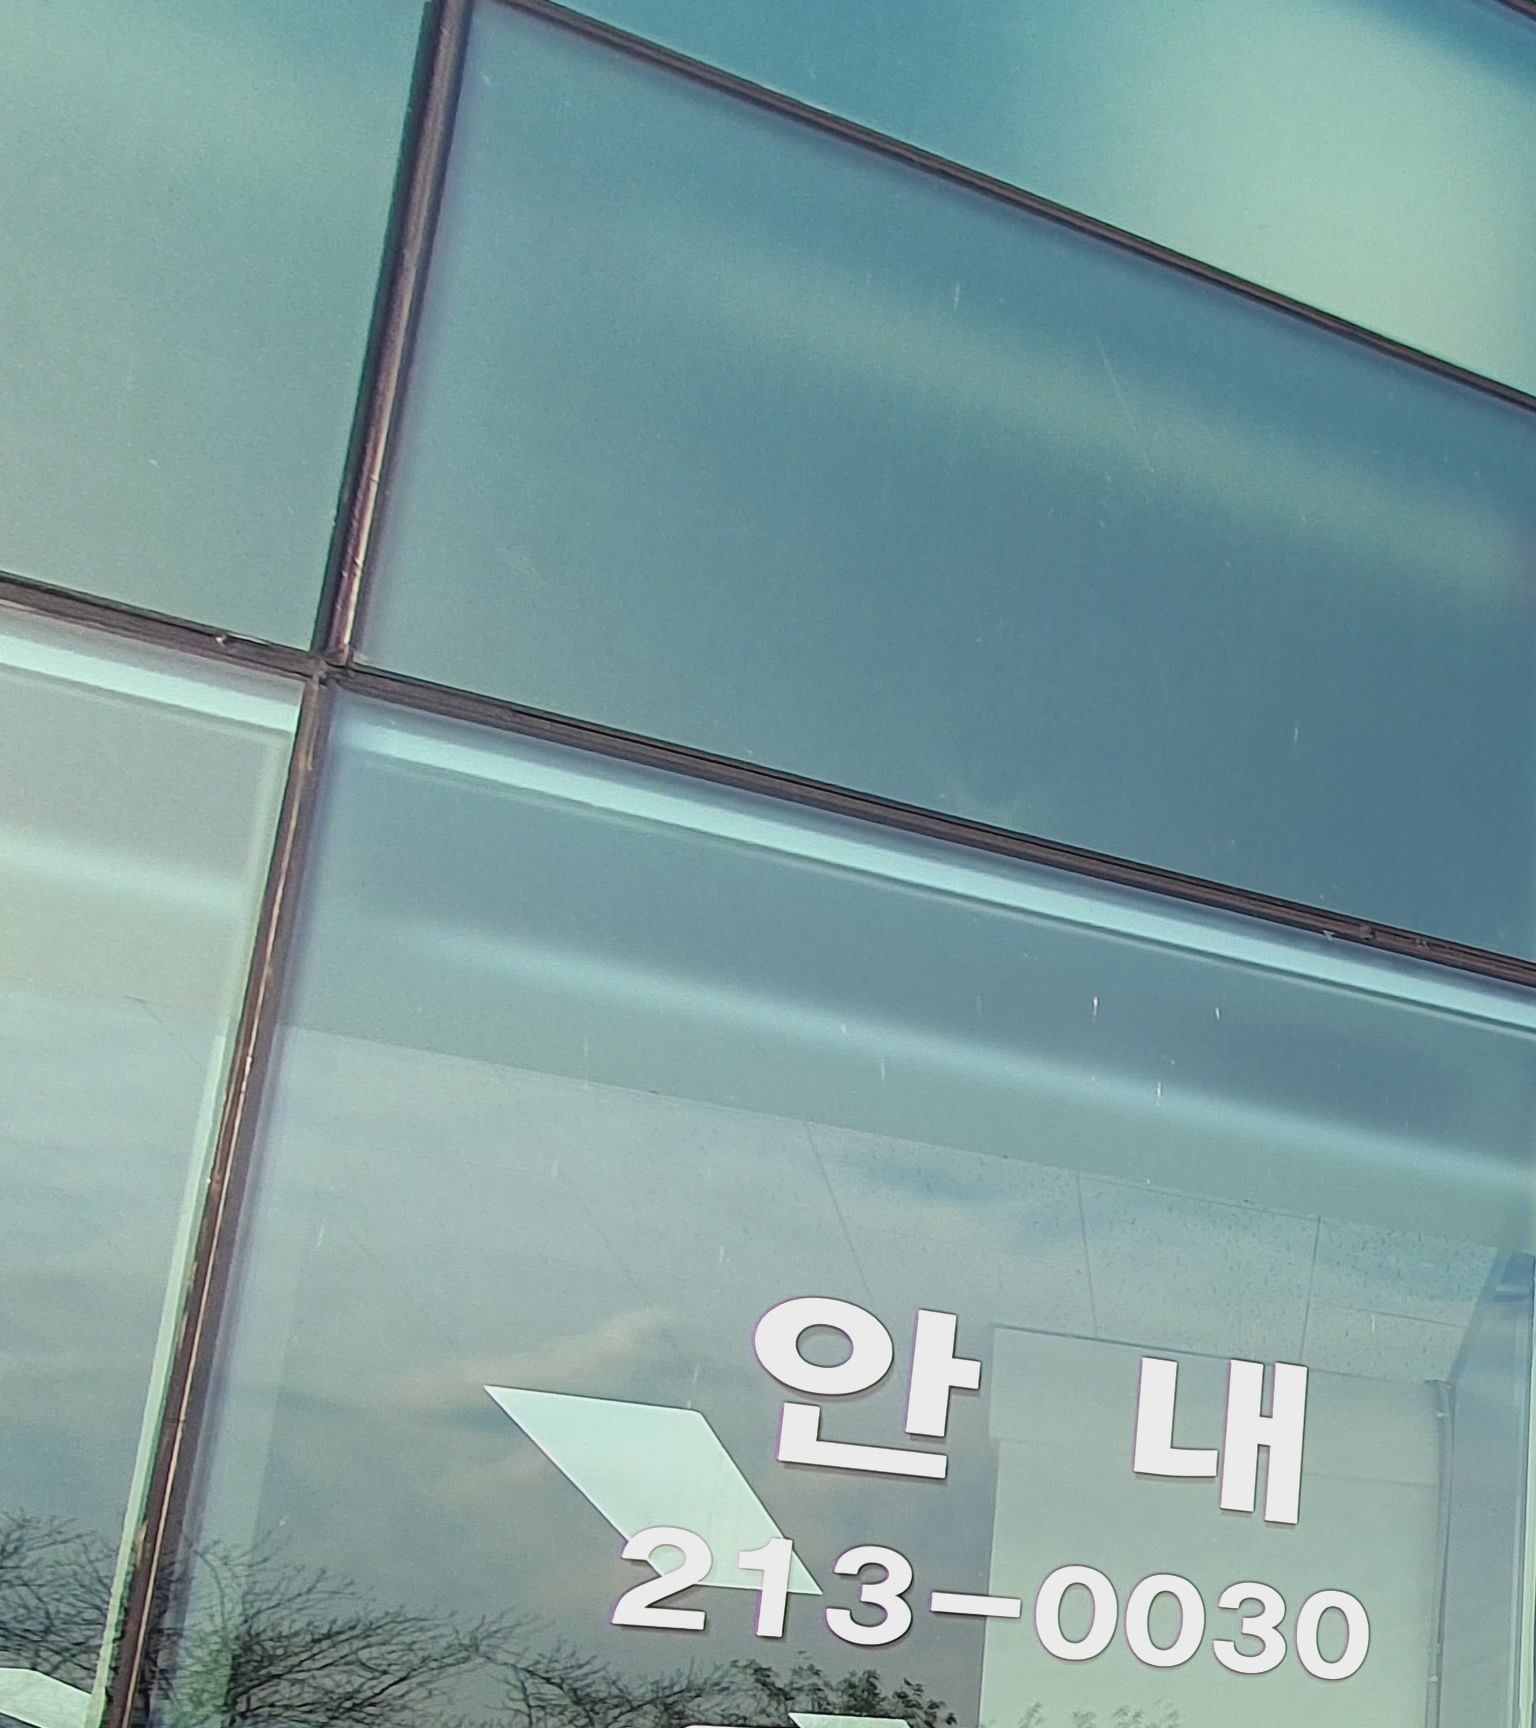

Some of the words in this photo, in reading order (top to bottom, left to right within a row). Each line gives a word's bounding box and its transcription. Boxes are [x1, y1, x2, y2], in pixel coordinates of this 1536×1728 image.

[754, 1296, 981, 1479] 안
[1132, 1357, 1308, 1524] 내
[610, 1526, 1371, 1681] 213-0030
